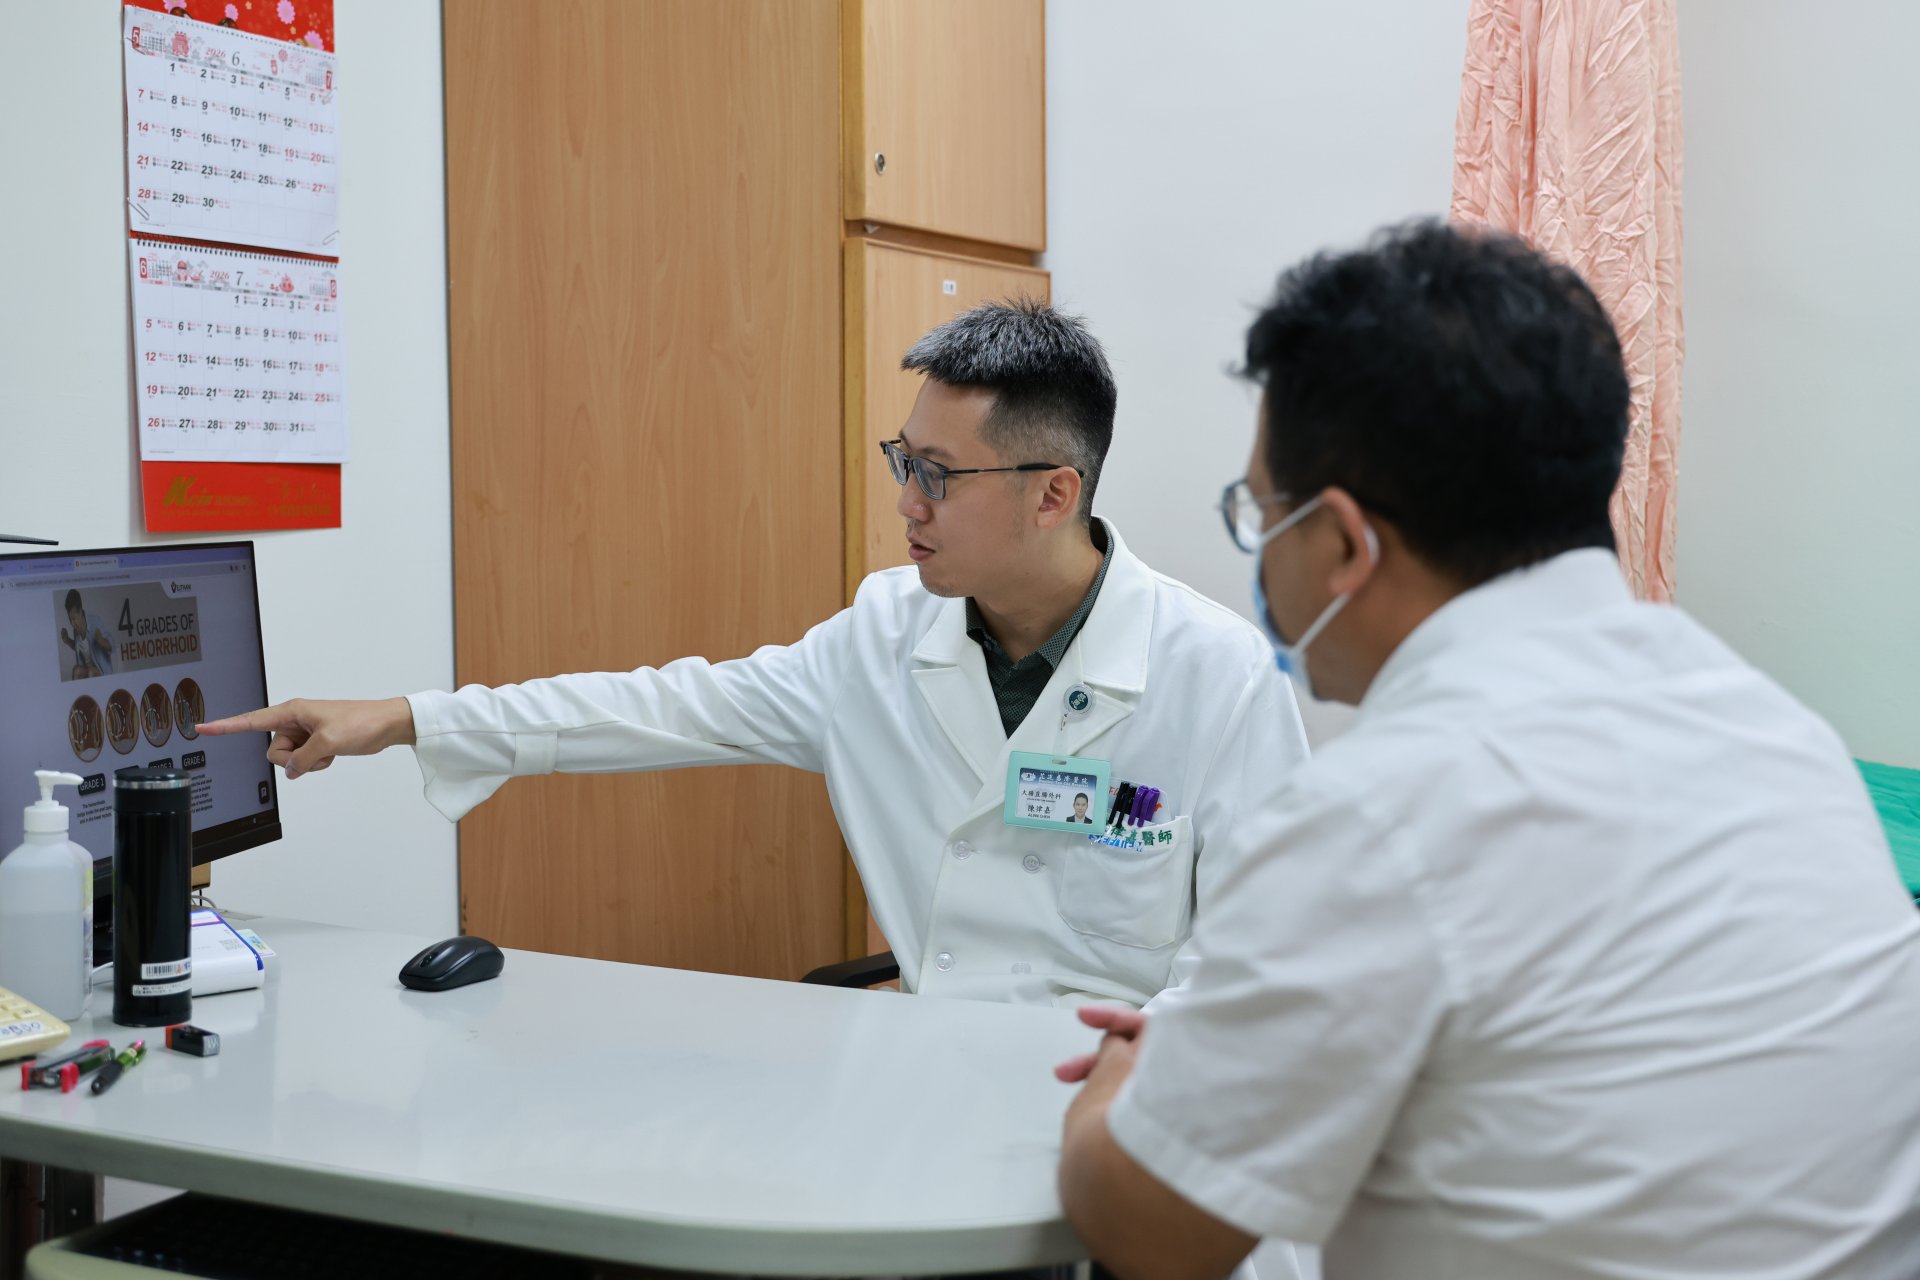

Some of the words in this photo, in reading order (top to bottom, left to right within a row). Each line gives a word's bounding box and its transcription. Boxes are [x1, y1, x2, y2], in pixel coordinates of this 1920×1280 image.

[206, 48, 226, 58] 2026
[232, 52, 240, 66] 6
[170, 63, 175, 72] 1
[200, 69, 207, 78] 2
[230, 75, 236, 84] 3
[259, 82, 264, 90] 4
[285, 87, 290, 96] 5
[138, 89, 144, 98] 7
[172, 96, 177, 104] 8
[202, 101, 208, 110] 9
[230, 106, 240, 116] 10
[258, 112, 266, 121] 11
[284, 118, 293, 127] 12
[310, 122, 318, 132] 13
[138, 122, 148, 132] 14
[171, 128, 182, 138] 15
[202, 133, 212, 143] 16
[231, 138, 241, 147] 17
[258, 144, 268, 153] 18
[285, 148, 294, 158] 19
[310, 152, 322, 162] 20
[137, 155, 149, 165] 21
[171, 160, 183, 170] 22
[201, 165, 213, 175] 23
[230, 170, 242, 179] 24
[258, 174, 268, 184] 25
[285, 179, 296, 188] 26
[312, 184, 323, 192] 27
[138, 189, 151, 198] 28
[172, 193, 184, 203] 29
[202, 198, 214, 208] 30
[210, 271, 229, 280] 2026
[236, 272, 243, 285] 7
[235, 296, 239, 304] 1
[262, 298, 268, 306] 2
[289, 300, 294, 310] 3
[146, 319, 152, 328] 5
[178, 322, 184, 330] 6
[208, 324, 212, 332] 7
[235, 326, 241, 335] 8
[264, 329, 269, 338] 9
[288, 331, 297, 340] 10
[314, 333, 322, 341] 11
[146, 352, 156, 361] 12
[178, 354, 188, 363] 13
[206, 356, 216, 364] 14
[234, 358, 244, 367] 15
[262, 360, 272, 368] 16
[289, 362, 298, 370] 17
[315, 364, 324, 372] 18
[147, 385, 158, 394] 19
[178, 386, 189, 396] 20
[206, 388, 216, 397] 21
[234, 389, 245, 398] 22
[262, 390, 273, 400] 23
[288, 392, 298, 400] 24
[314, 393, 325, 402] 25
[148, 418, 159, 427] 26
[179, 419, 190, 428] 27
[207, 420, 218, 429] 28
[235, 421, 246, 430] 29
[264, 422, 274, 431] 30
[290, 422, 299, 432] 31
[118, 598, 134, 637] 4
[137, 616, 178, 636] GRADES
[181, 613, 194, 630] OF
[121, 634, 198, 661] HEMORRHOID
[184, 756, 200, 767] GRADE
[80, 778, 100, 790] GRADE
[100, 778, 104, 786] 1
